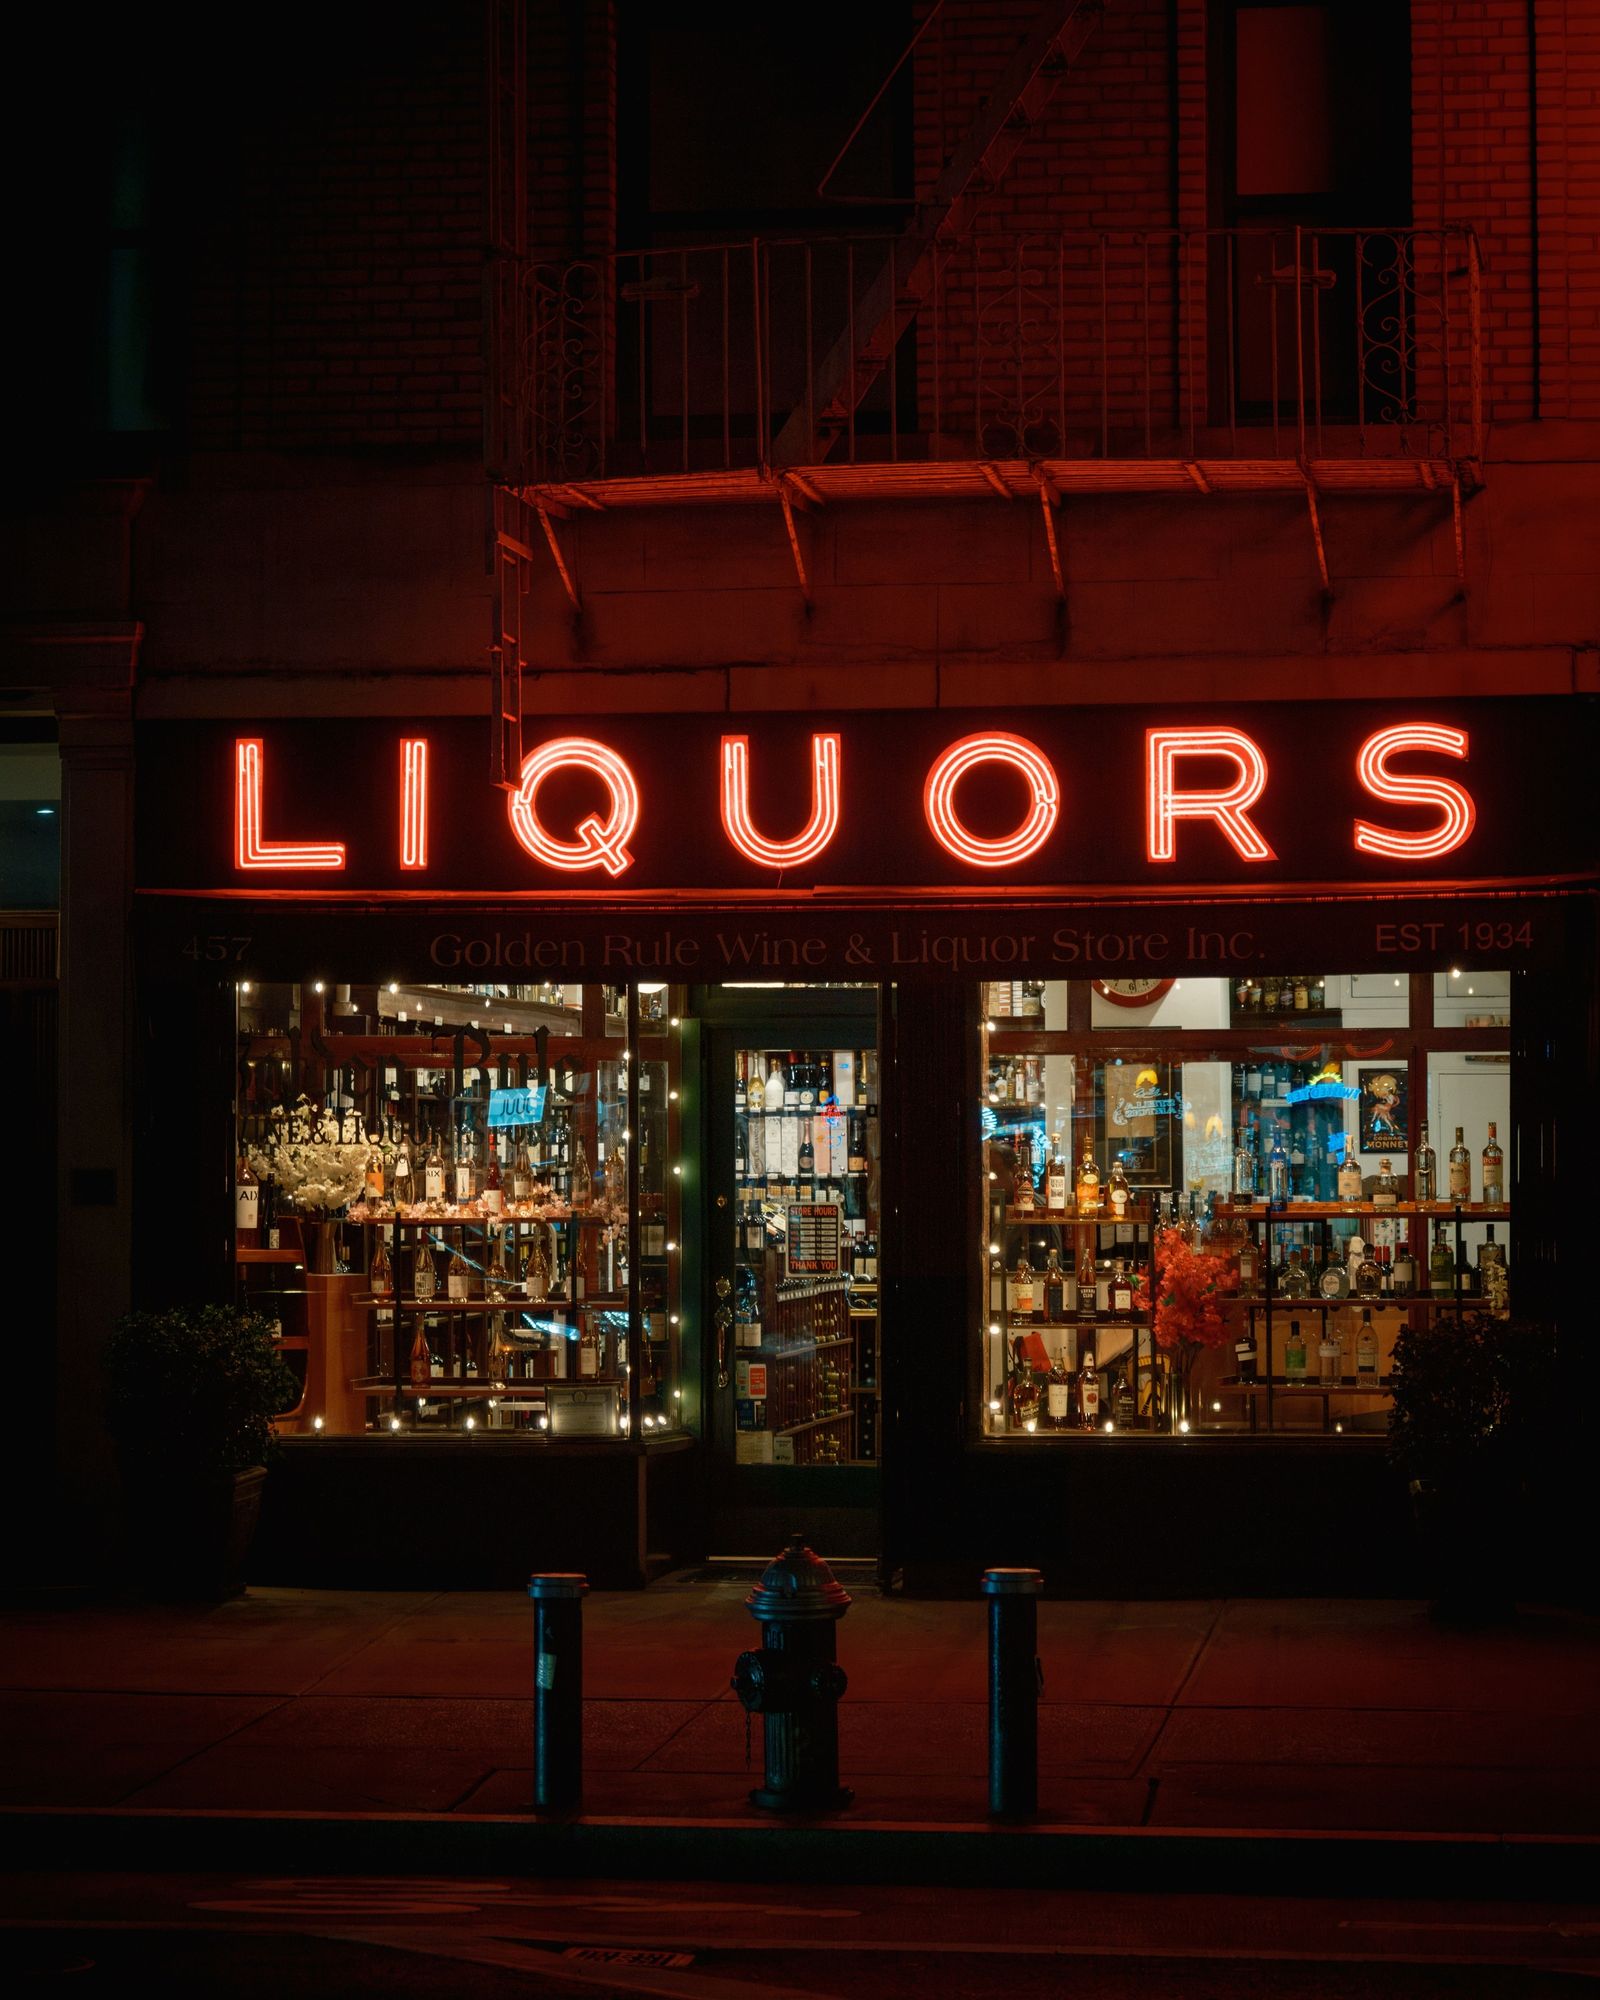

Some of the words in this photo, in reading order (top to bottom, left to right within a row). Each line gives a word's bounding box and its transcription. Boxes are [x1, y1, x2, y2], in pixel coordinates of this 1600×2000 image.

[234, 721, 1477, 879] LIQUORS
[180, 935, 252, 961] 457
[1376, 922, 1445, 952] EST
[1457, 920, 1535, 951] 1934
[430, 932, 586, 967] Golden
[603, 931, 699, 967] Rule
[716, 930, 827, 966] Wine
[845, 932, 875, 965] &
[891, 929, 1036, 972] Liquor
[1052, 928, 1169, 962] Store
[1186, 927, 1265, 960] Inc.
[426, 1169, 440, 1178] AIX
[790, 1206, 812, 1216] STORE
[813, 1206, 837, 1216] HOURS
[790, 1261, 818, 1270] THANK
[820, 1261, 837, 1270] YOU
